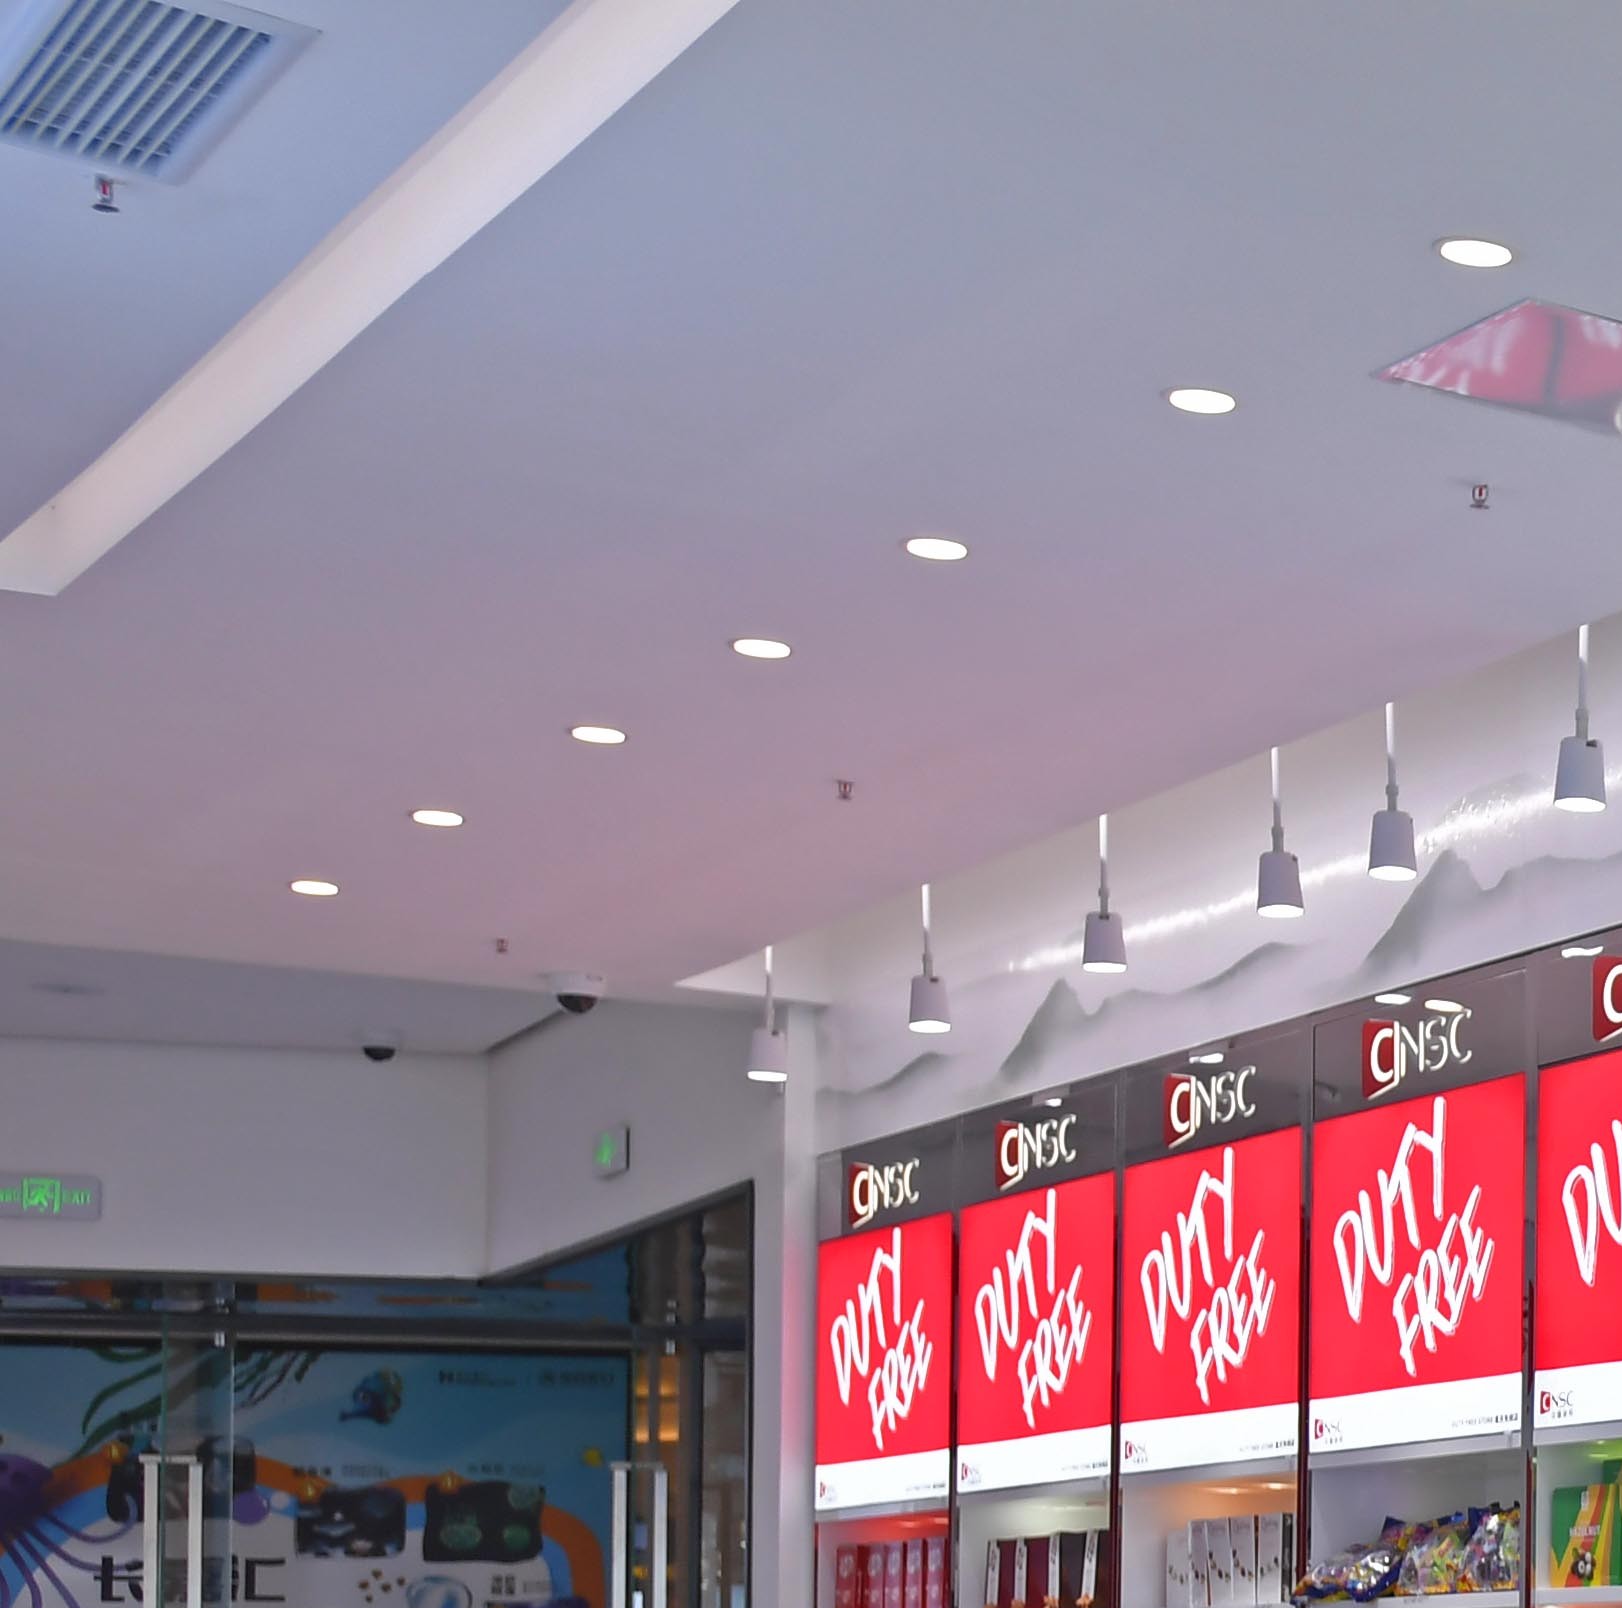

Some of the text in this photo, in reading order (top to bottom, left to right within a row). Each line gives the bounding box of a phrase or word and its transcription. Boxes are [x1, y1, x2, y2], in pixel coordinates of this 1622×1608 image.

[1167, 1065, 1256, 1140] CNSC
[1367, 1008, 1473, 1089] CNSC
[998, 1114, 1077, 1182] CNSC
[1333, 1096, 1446, 1324] DUTY
[830, 1226, 901, 1407] DUTY
[975, 1188, 1056, 1383] DUTY
[1140, 1146, 1234, 1354] DUTY
[1190, 1229, 1275, 1406] FREE
[1393, 1184, 1495, 1377] FREE
[868, 1299, 932, 1452] FREE
[1017, 1265, 1092, 1429] FREE
